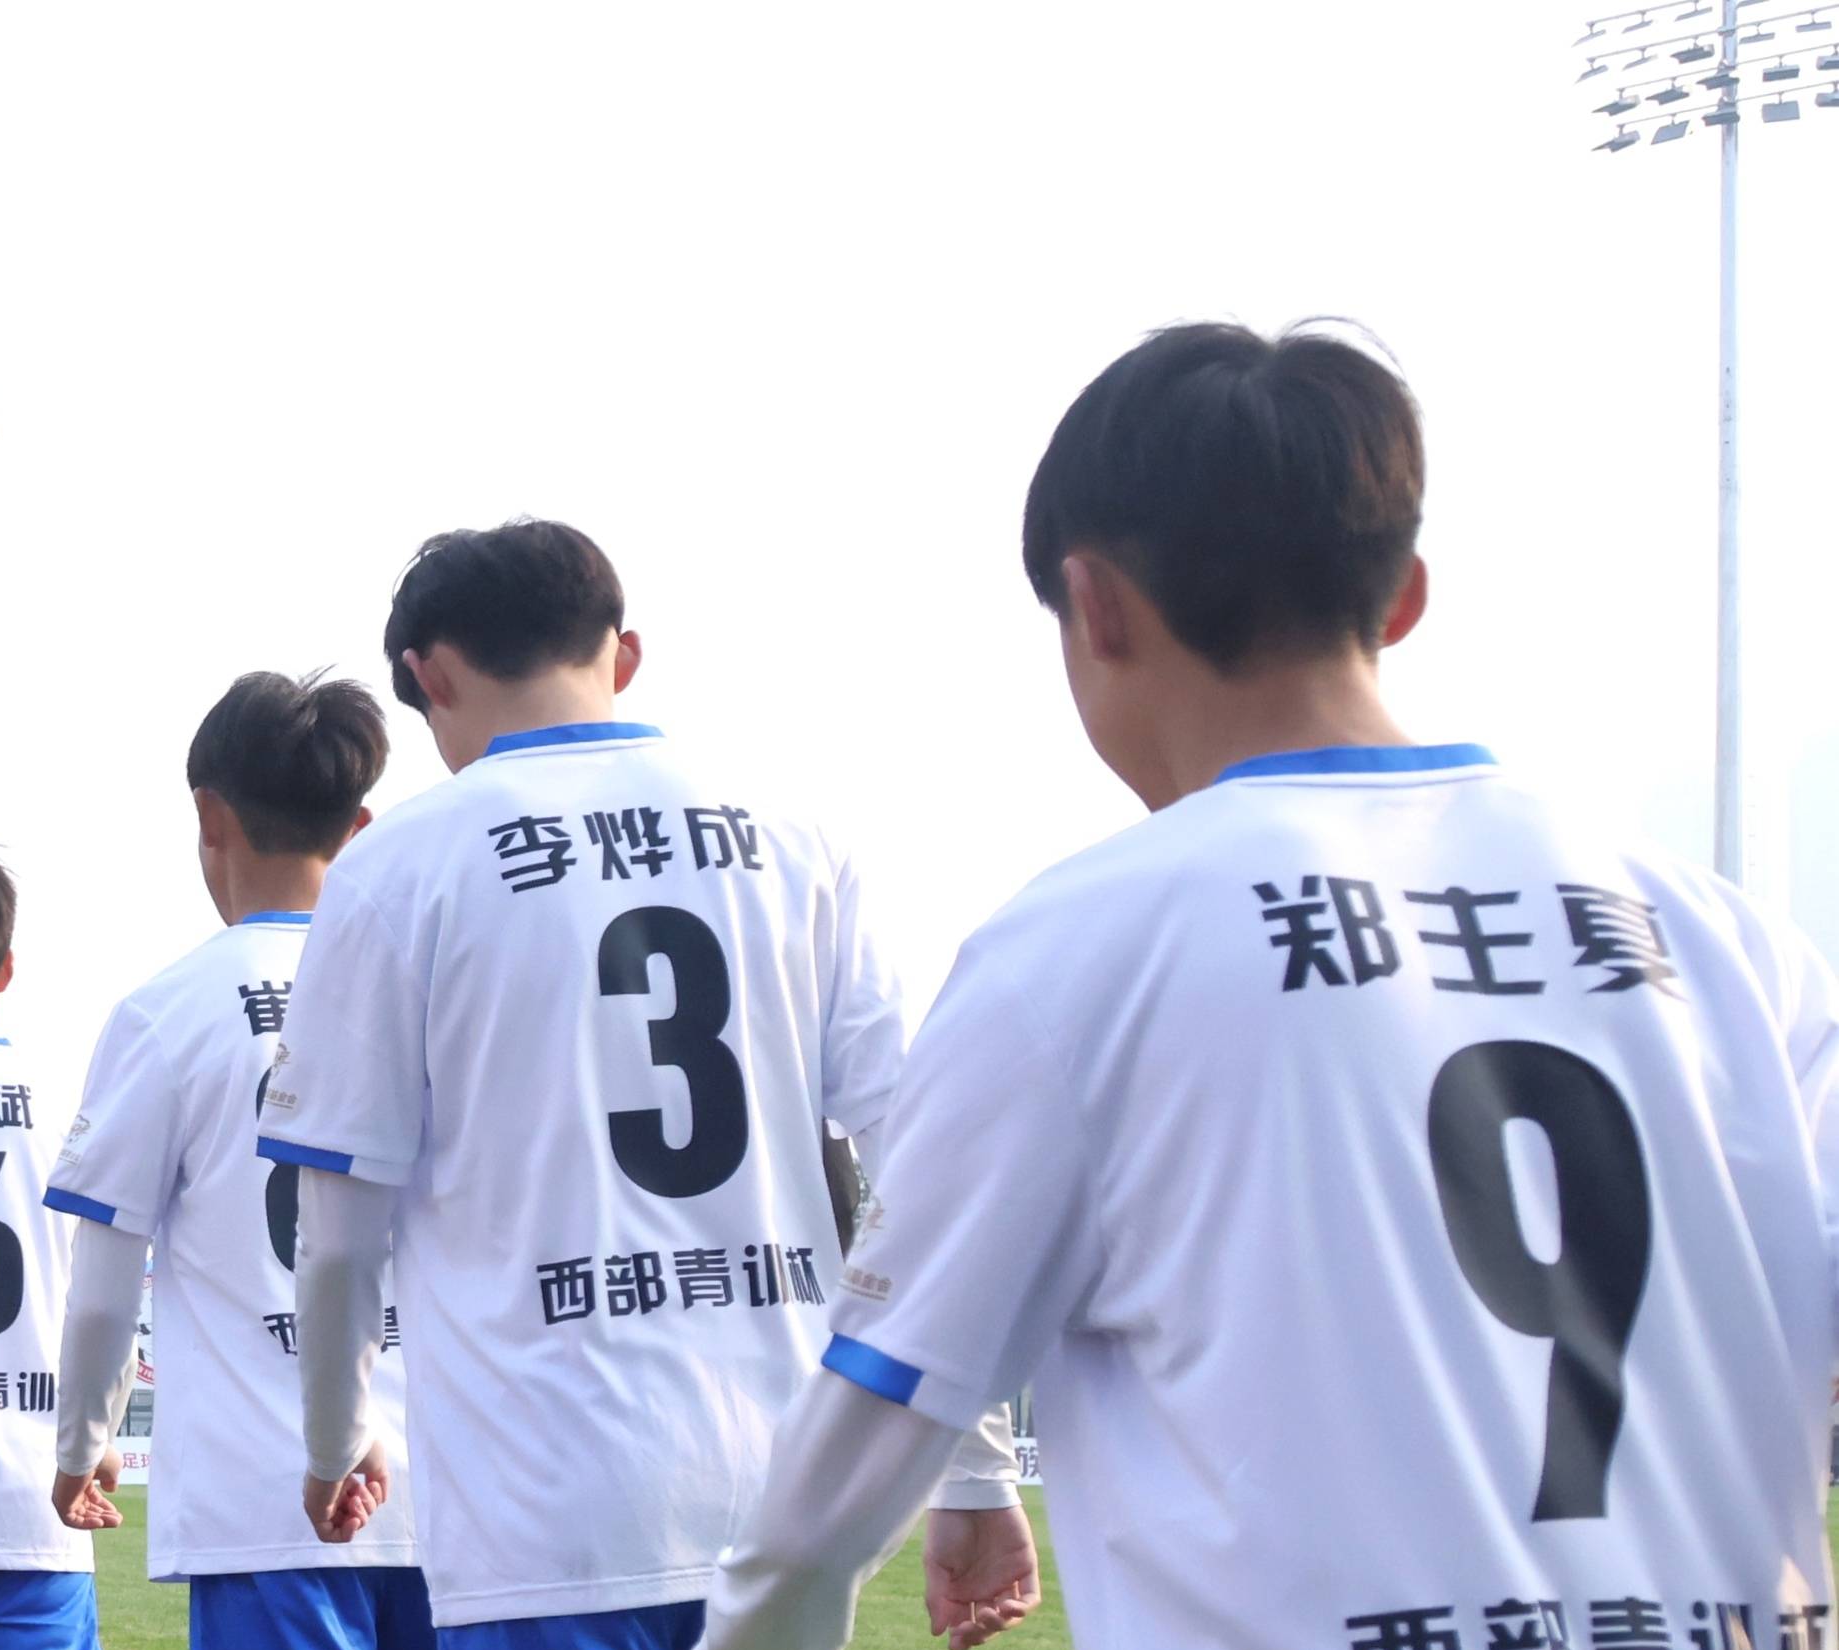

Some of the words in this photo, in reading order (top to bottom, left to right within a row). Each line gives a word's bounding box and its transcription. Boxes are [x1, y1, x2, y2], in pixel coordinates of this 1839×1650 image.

[488, 804, 764, 894] 李烨成
[597, 905, 749, 1199] 3
[535, 1243, 826, 1325] 西部青训杯
[1427, 1039, 1653, 1523] 9
